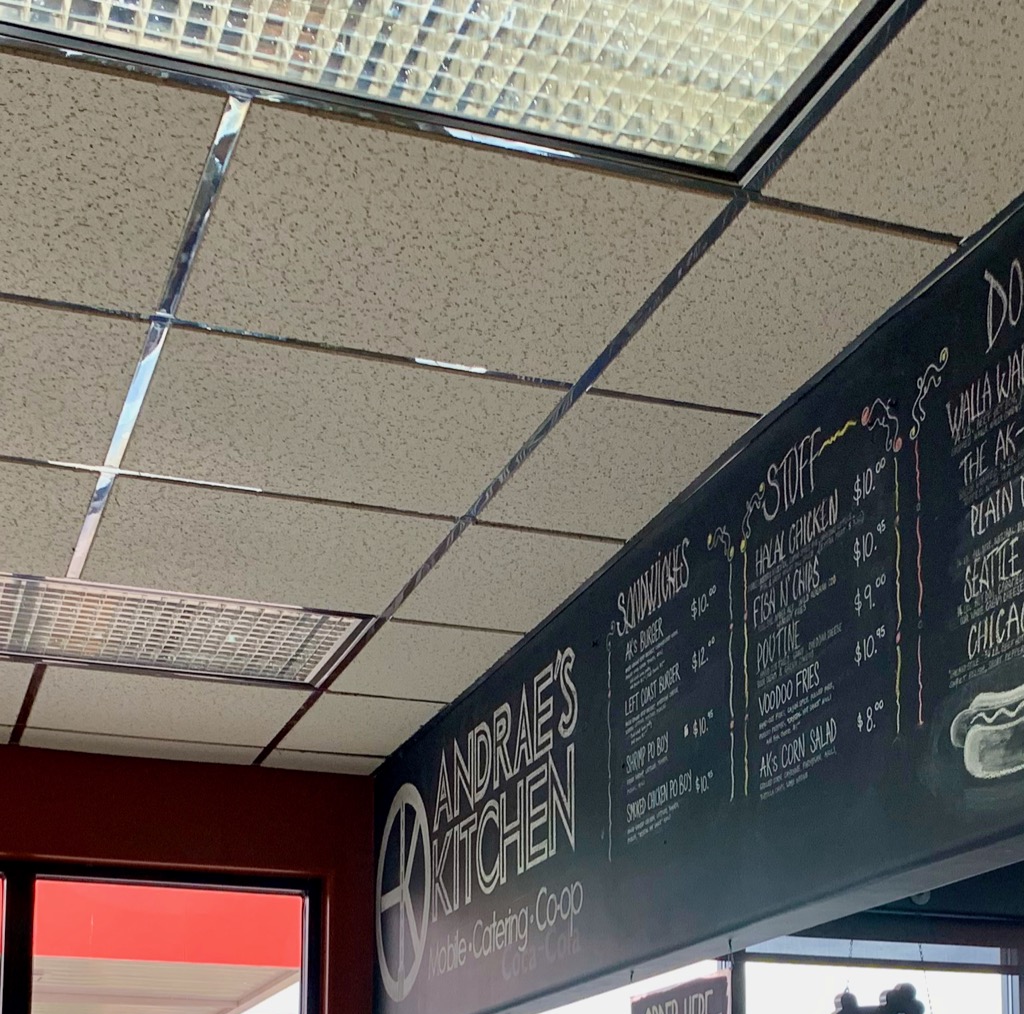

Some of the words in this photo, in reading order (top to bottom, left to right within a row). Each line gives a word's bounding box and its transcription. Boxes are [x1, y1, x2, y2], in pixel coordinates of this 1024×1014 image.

[945, 371, 992, 445] WALLA
[958, 439, 989, 487] THE
[755, 530, 786, 577] HALAL
[788, 488, 839, 554] CHICKEN
[970, 482, 1014, 538] PLAIN
[753, 586, 776, 629] FISH
[792, 555, 820, 601] CHIPS
[963, 536, 1023, 604] SEATTLE
[756, 619, 801, 675] POUTINE
[624, 691, 640, 716] LEFT
[758, 679, 793, 717] VOODOO
[796, 661, 820, 698] FRIES
[432, 646, 578, 832] ANDRAE'S
[781, 732, 805, 769] CORN
[809, 717, 837, 754] SALAD
[431, 743, 576, 922] KITCHEN
[427, 937, 467, 981] Mobile
[473, 905, 529, 961] Catering
